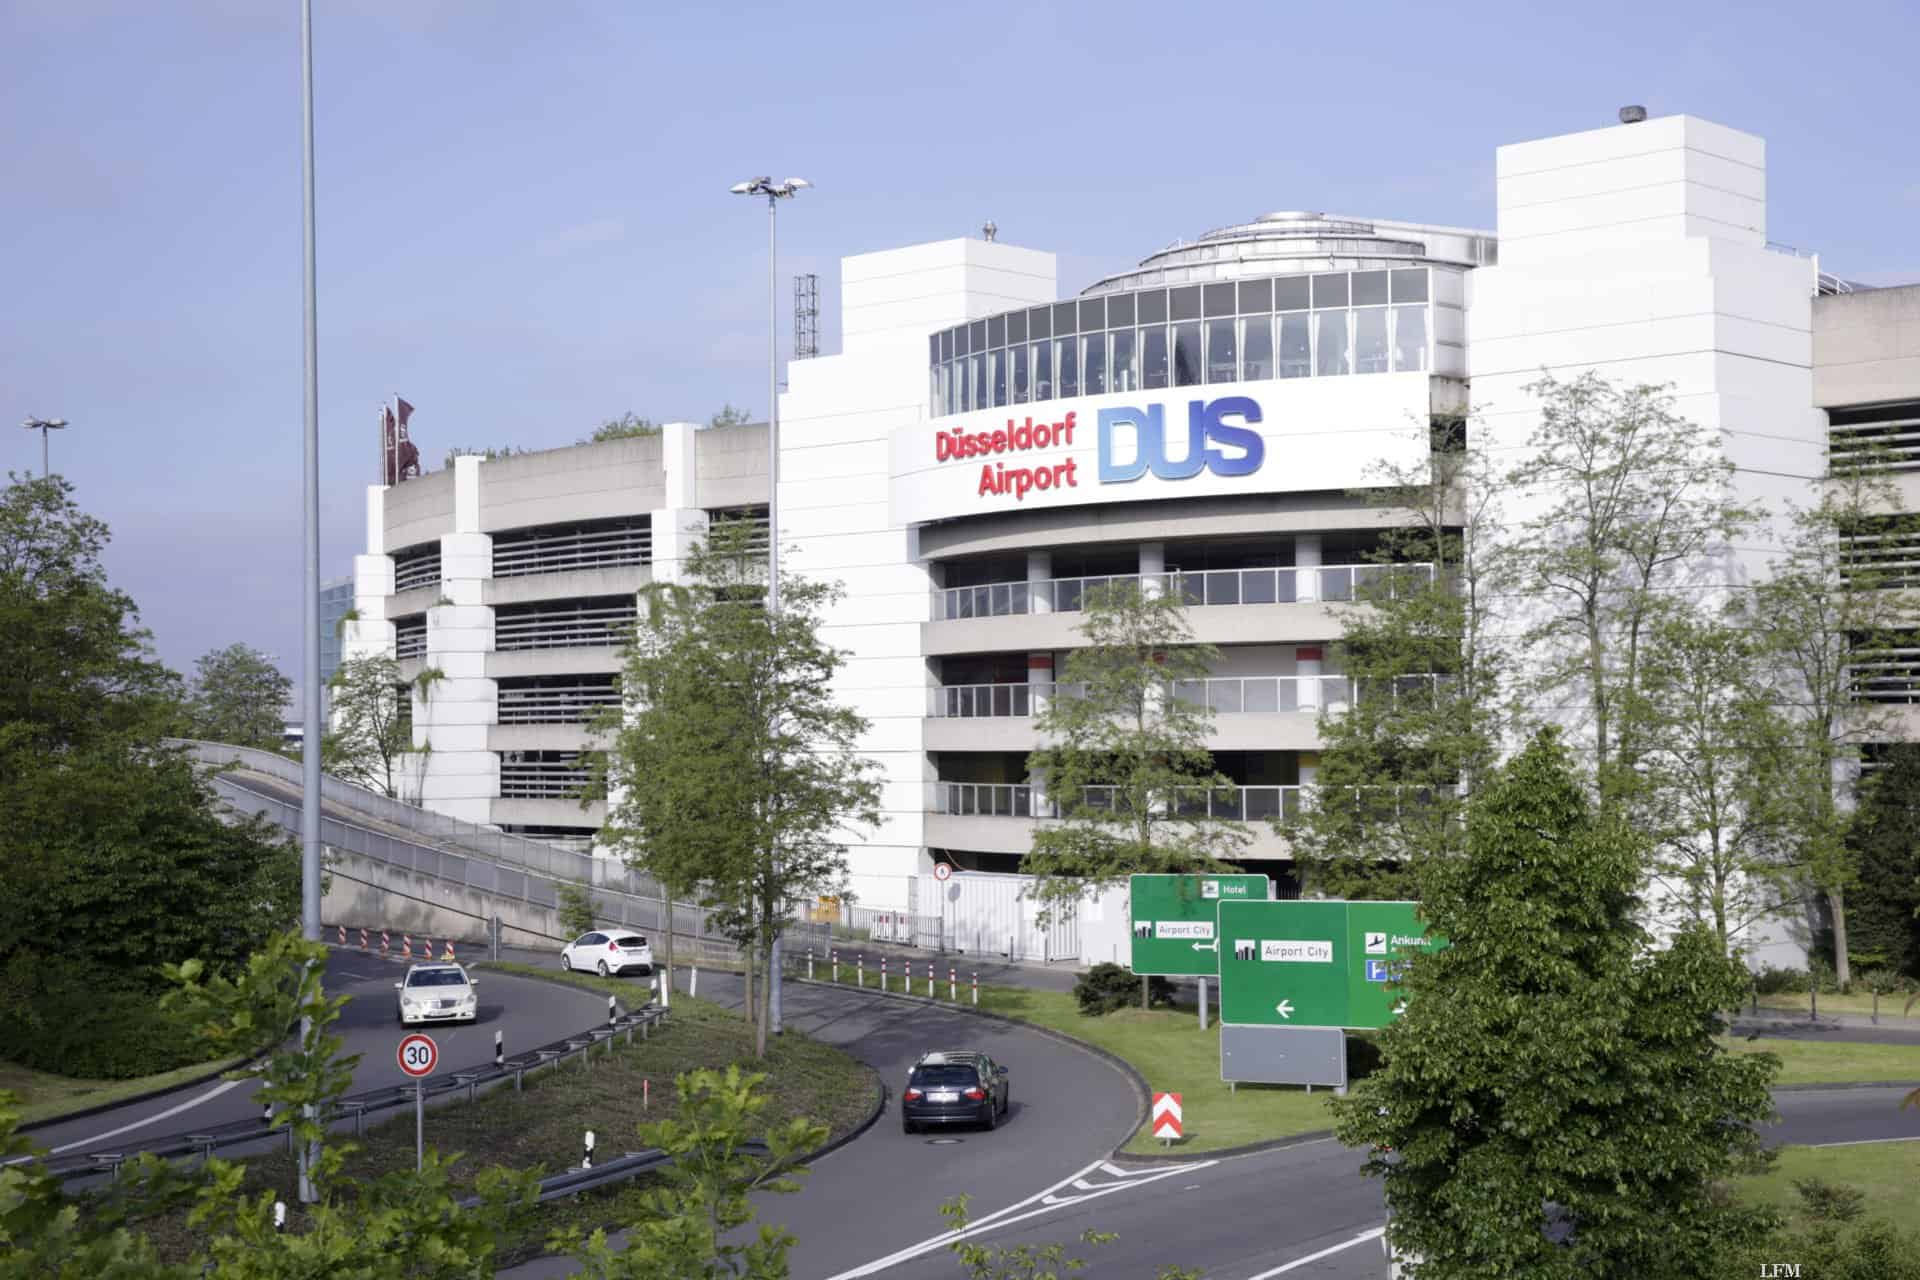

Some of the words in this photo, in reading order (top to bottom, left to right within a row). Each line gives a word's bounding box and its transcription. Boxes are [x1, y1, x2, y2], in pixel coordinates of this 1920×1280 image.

[936, 411, 1077, 461] Düsseldorf
[1097, 396, 1265, 485] DUS
[978, 457, 1077, 500] Airport
[1223, 884, 1247, 895] Hotel
[1159, 925, 1191, 936] Airport
[1193, 924, 1210, 937] City
[1265, 946, 1303, 958] Airport
[1307, 946, 1329, 959] City
[407, 1046, 429, 1065] 30
